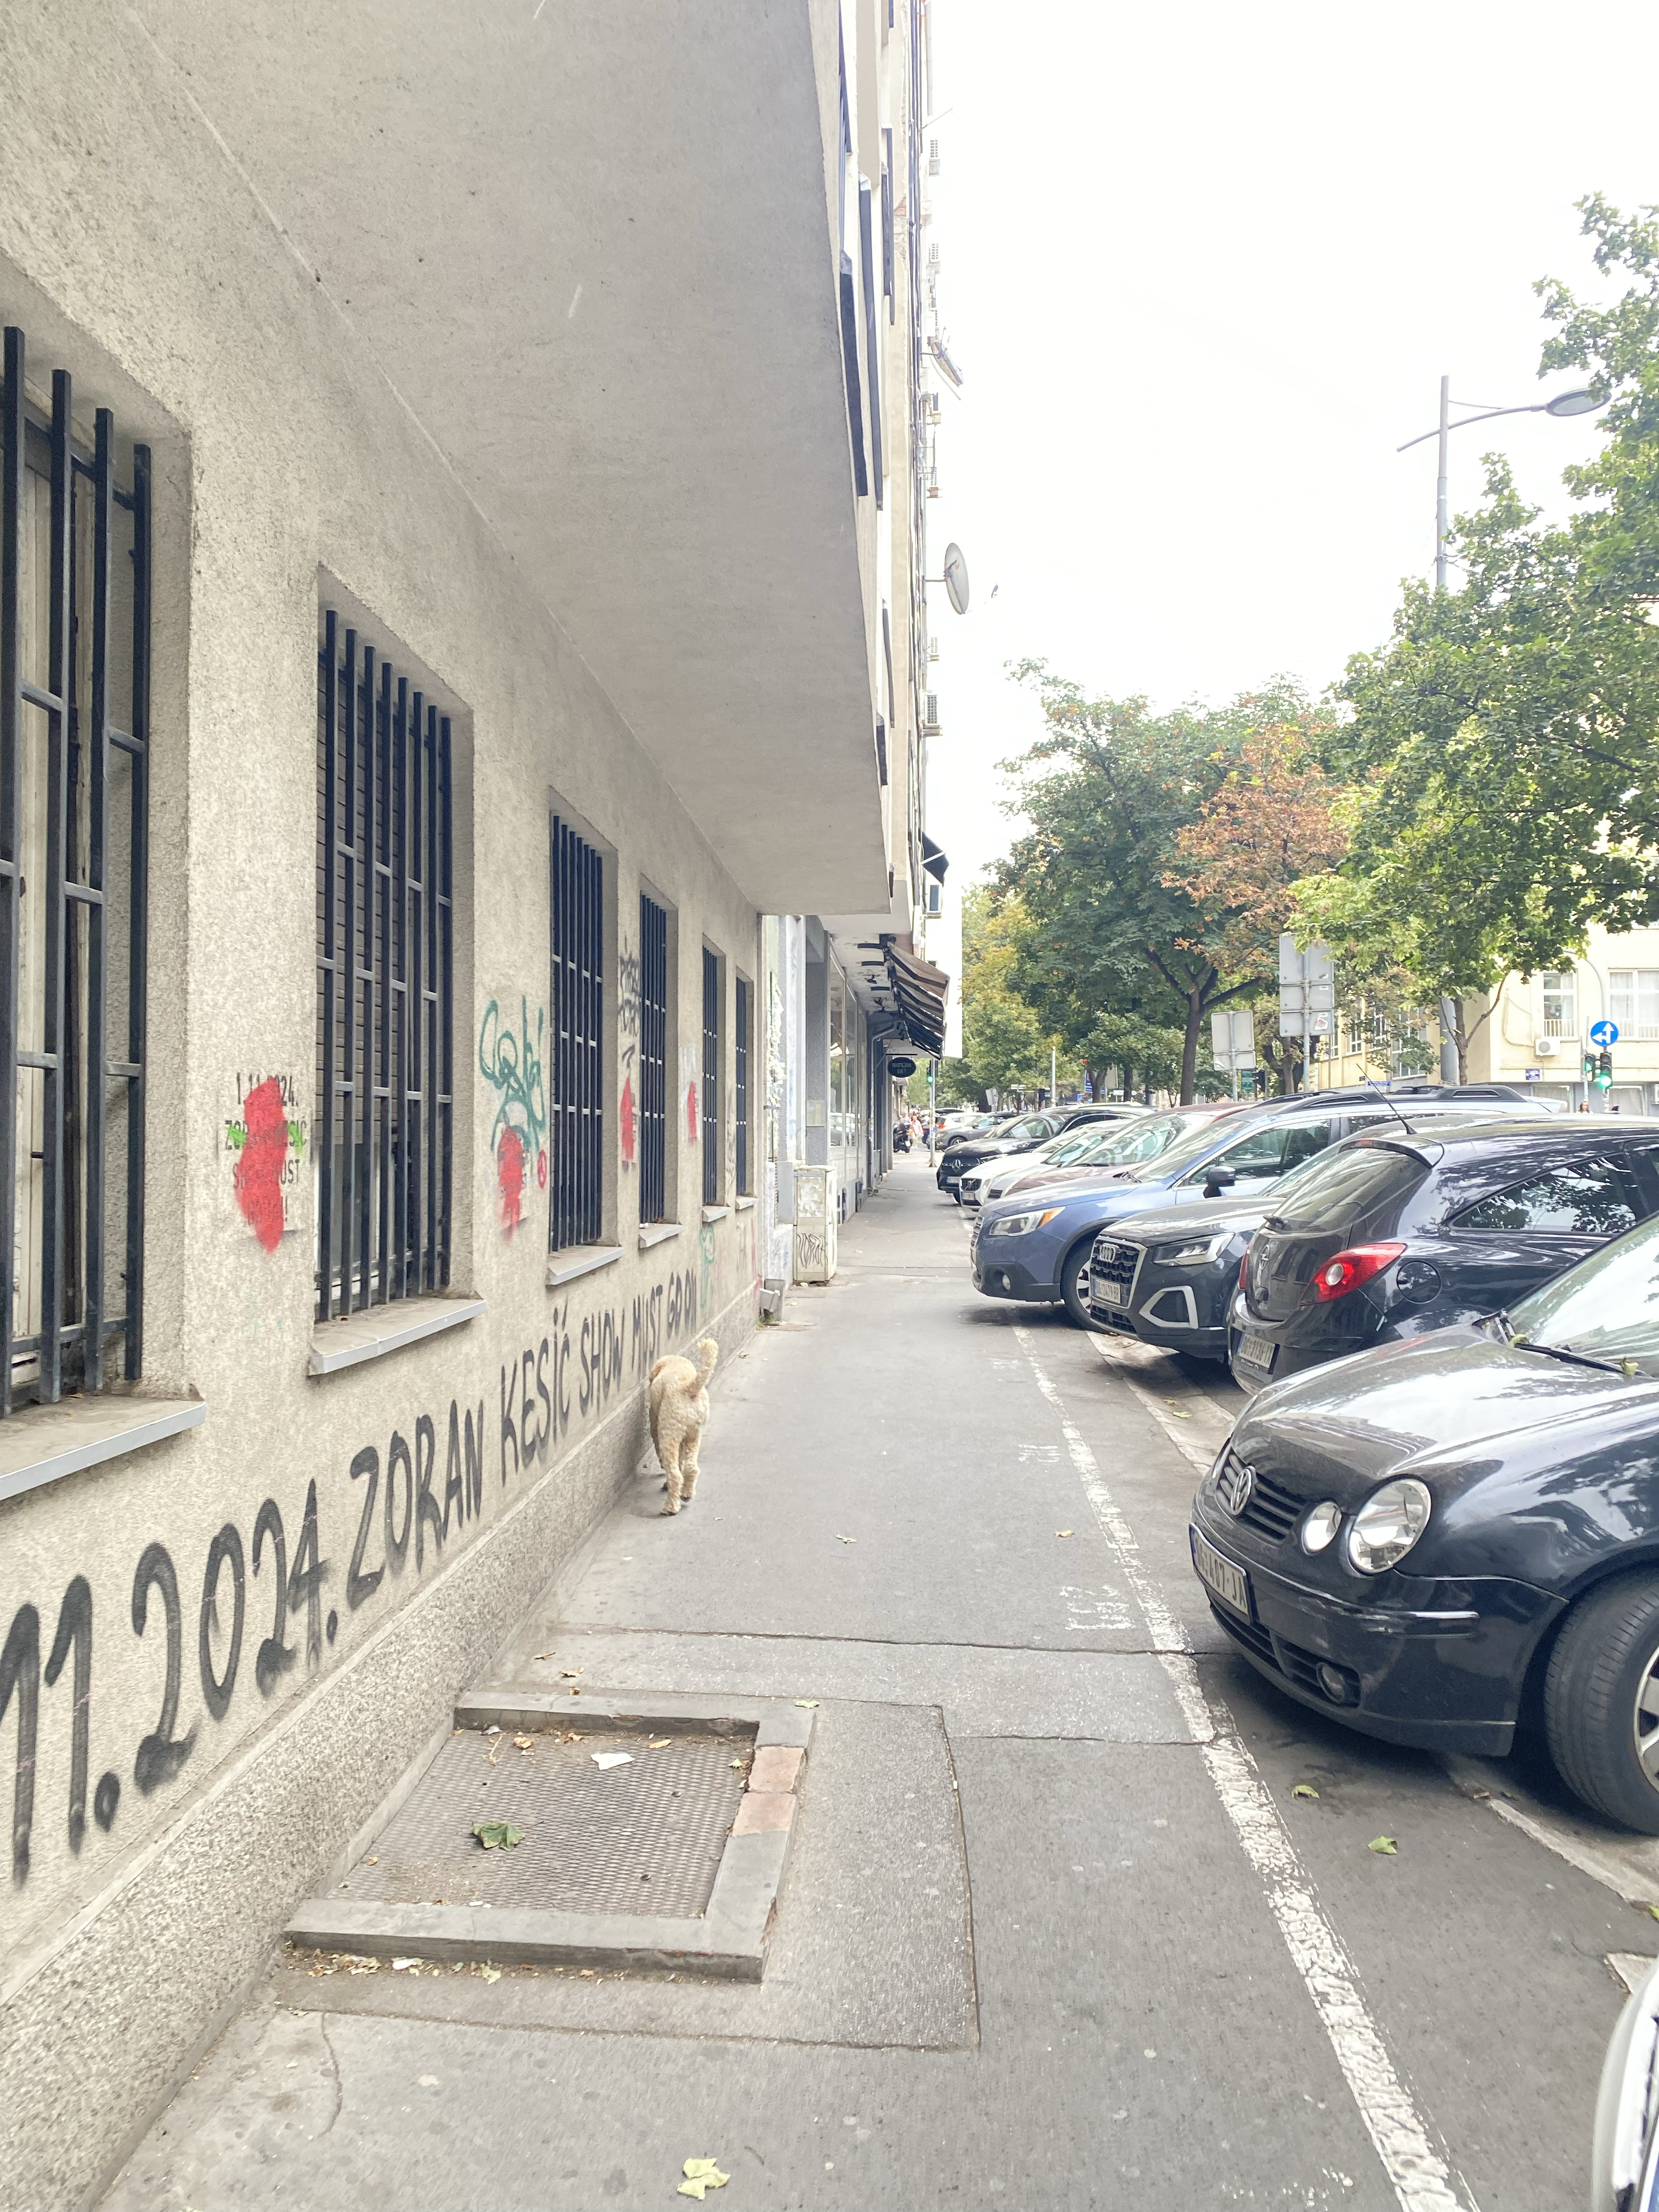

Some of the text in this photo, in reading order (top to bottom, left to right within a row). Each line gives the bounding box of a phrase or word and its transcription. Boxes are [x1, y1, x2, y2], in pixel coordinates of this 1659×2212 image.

[347, 1398, 484, 1611] ZORAN
[580, 1308, 625, 1419] SHOW
[631, 1284, 663, 1380] MUST
